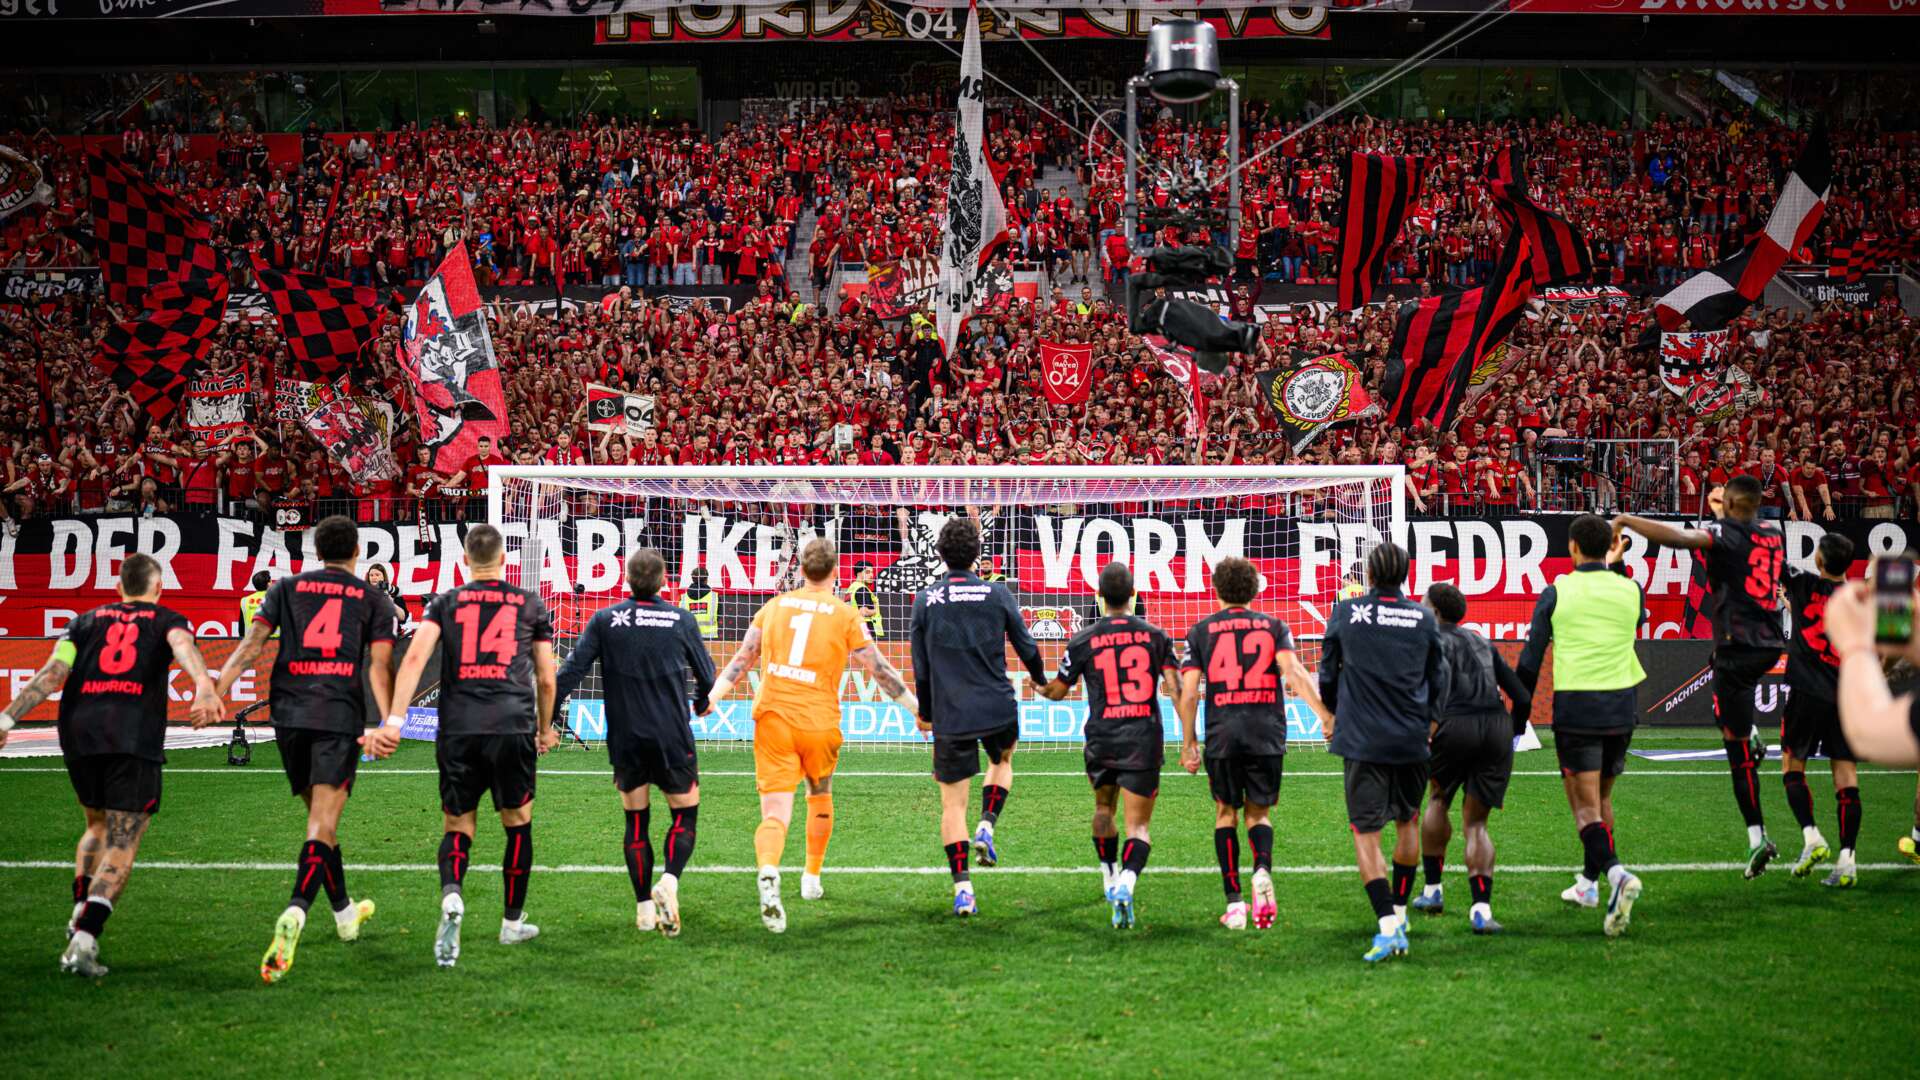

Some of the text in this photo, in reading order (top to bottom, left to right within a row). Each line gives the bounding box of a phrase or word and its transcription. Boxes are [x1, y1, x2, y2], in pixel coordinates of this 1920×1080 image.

[905, 7, 956, 39] 04
[1049, 371, 1079, 387] 04
[49, 516, 183, 591] DER
[296, 581, 365, 599] BAYER 04
[457, 590, 504, 603] BAYER
[303, 598, 343, 658] 4
[455, 603, 518, 665] 14
[1208, 618, 1270, 634] BAYER 04
[99, 621, 139, 675] 8
[789, 611, 814, 667] 1
[1090, 631, 1150, 649] BAYER 04
[459, 664, 508, 680] SCHICK
[1208, 630, 1277, 691] 42
[1094, 645, 1154, 705] 13
[80, 680, 143, 696] ANDRICH
[1103, 703, 1152, 718] ARTHUR
